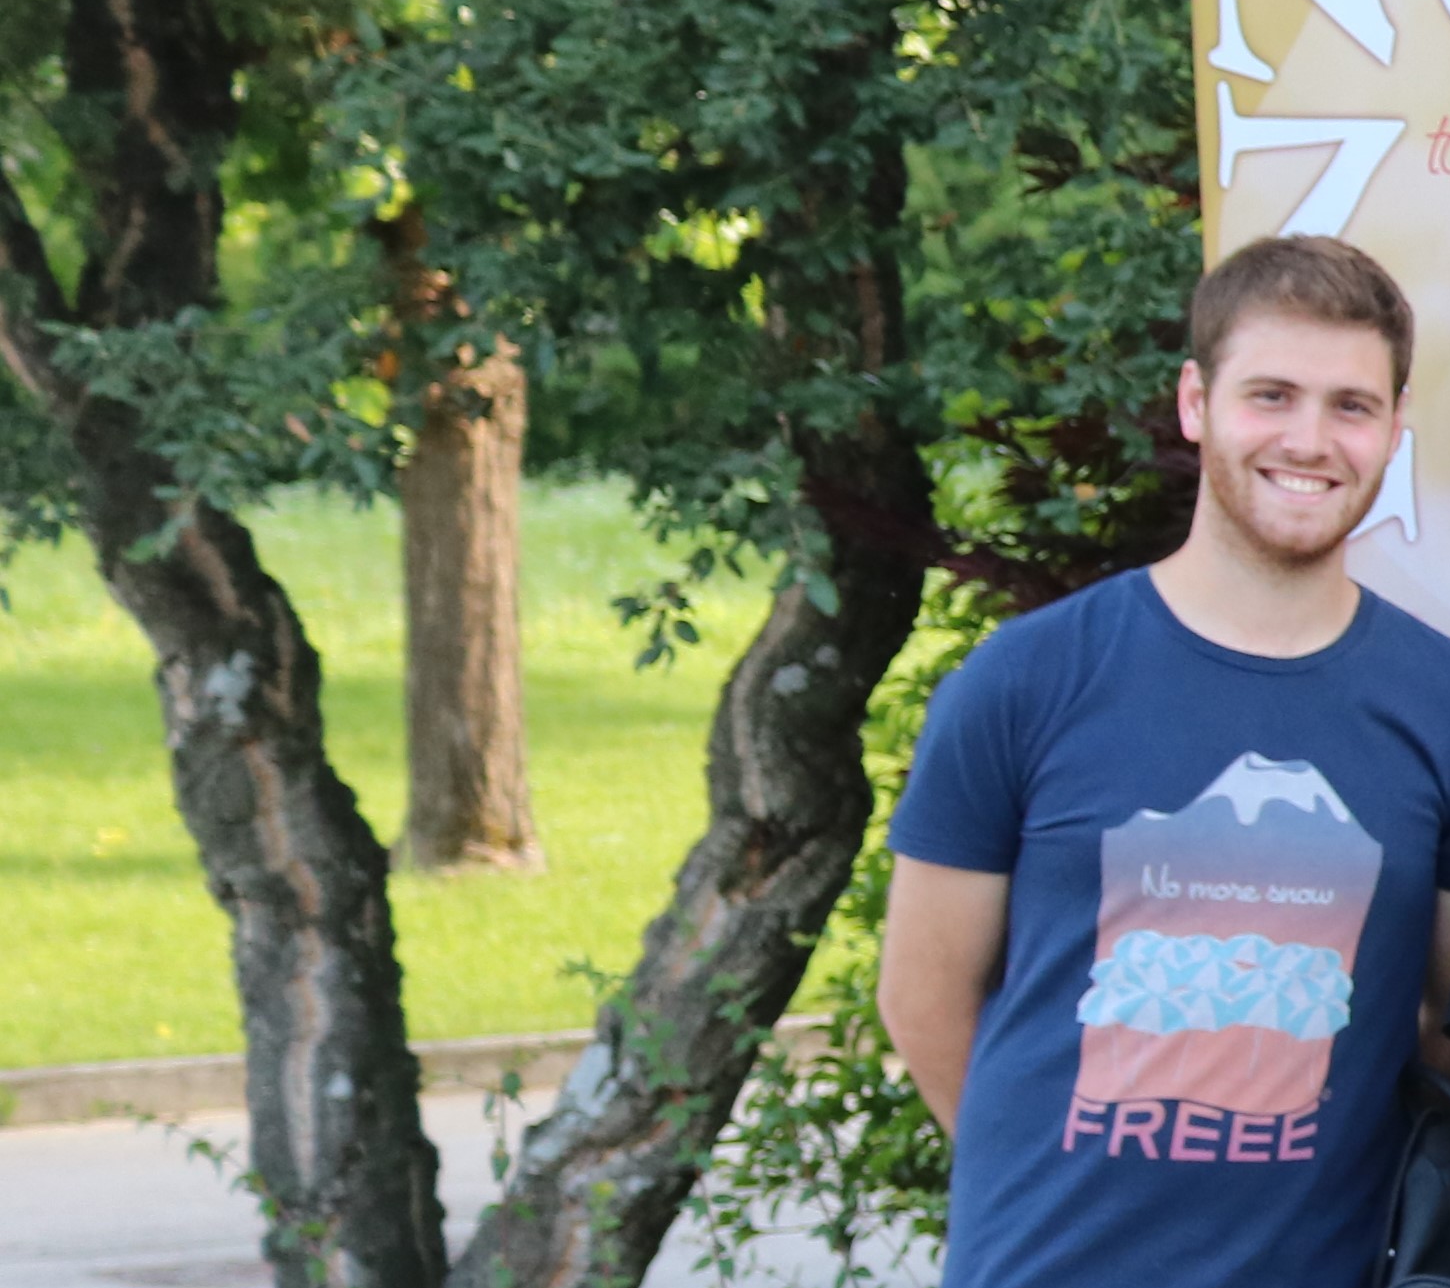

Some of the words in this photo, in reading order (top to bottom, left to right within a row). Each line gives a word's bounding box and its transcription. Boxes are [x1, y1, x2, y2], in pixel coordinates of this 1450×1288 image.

[1140, 863, 1182, 900] No
[1188, 881, 1261, 904] more
[1265, 883, 1336, 906] snow
[1061, 1093, 1319, 1162] FREEE
